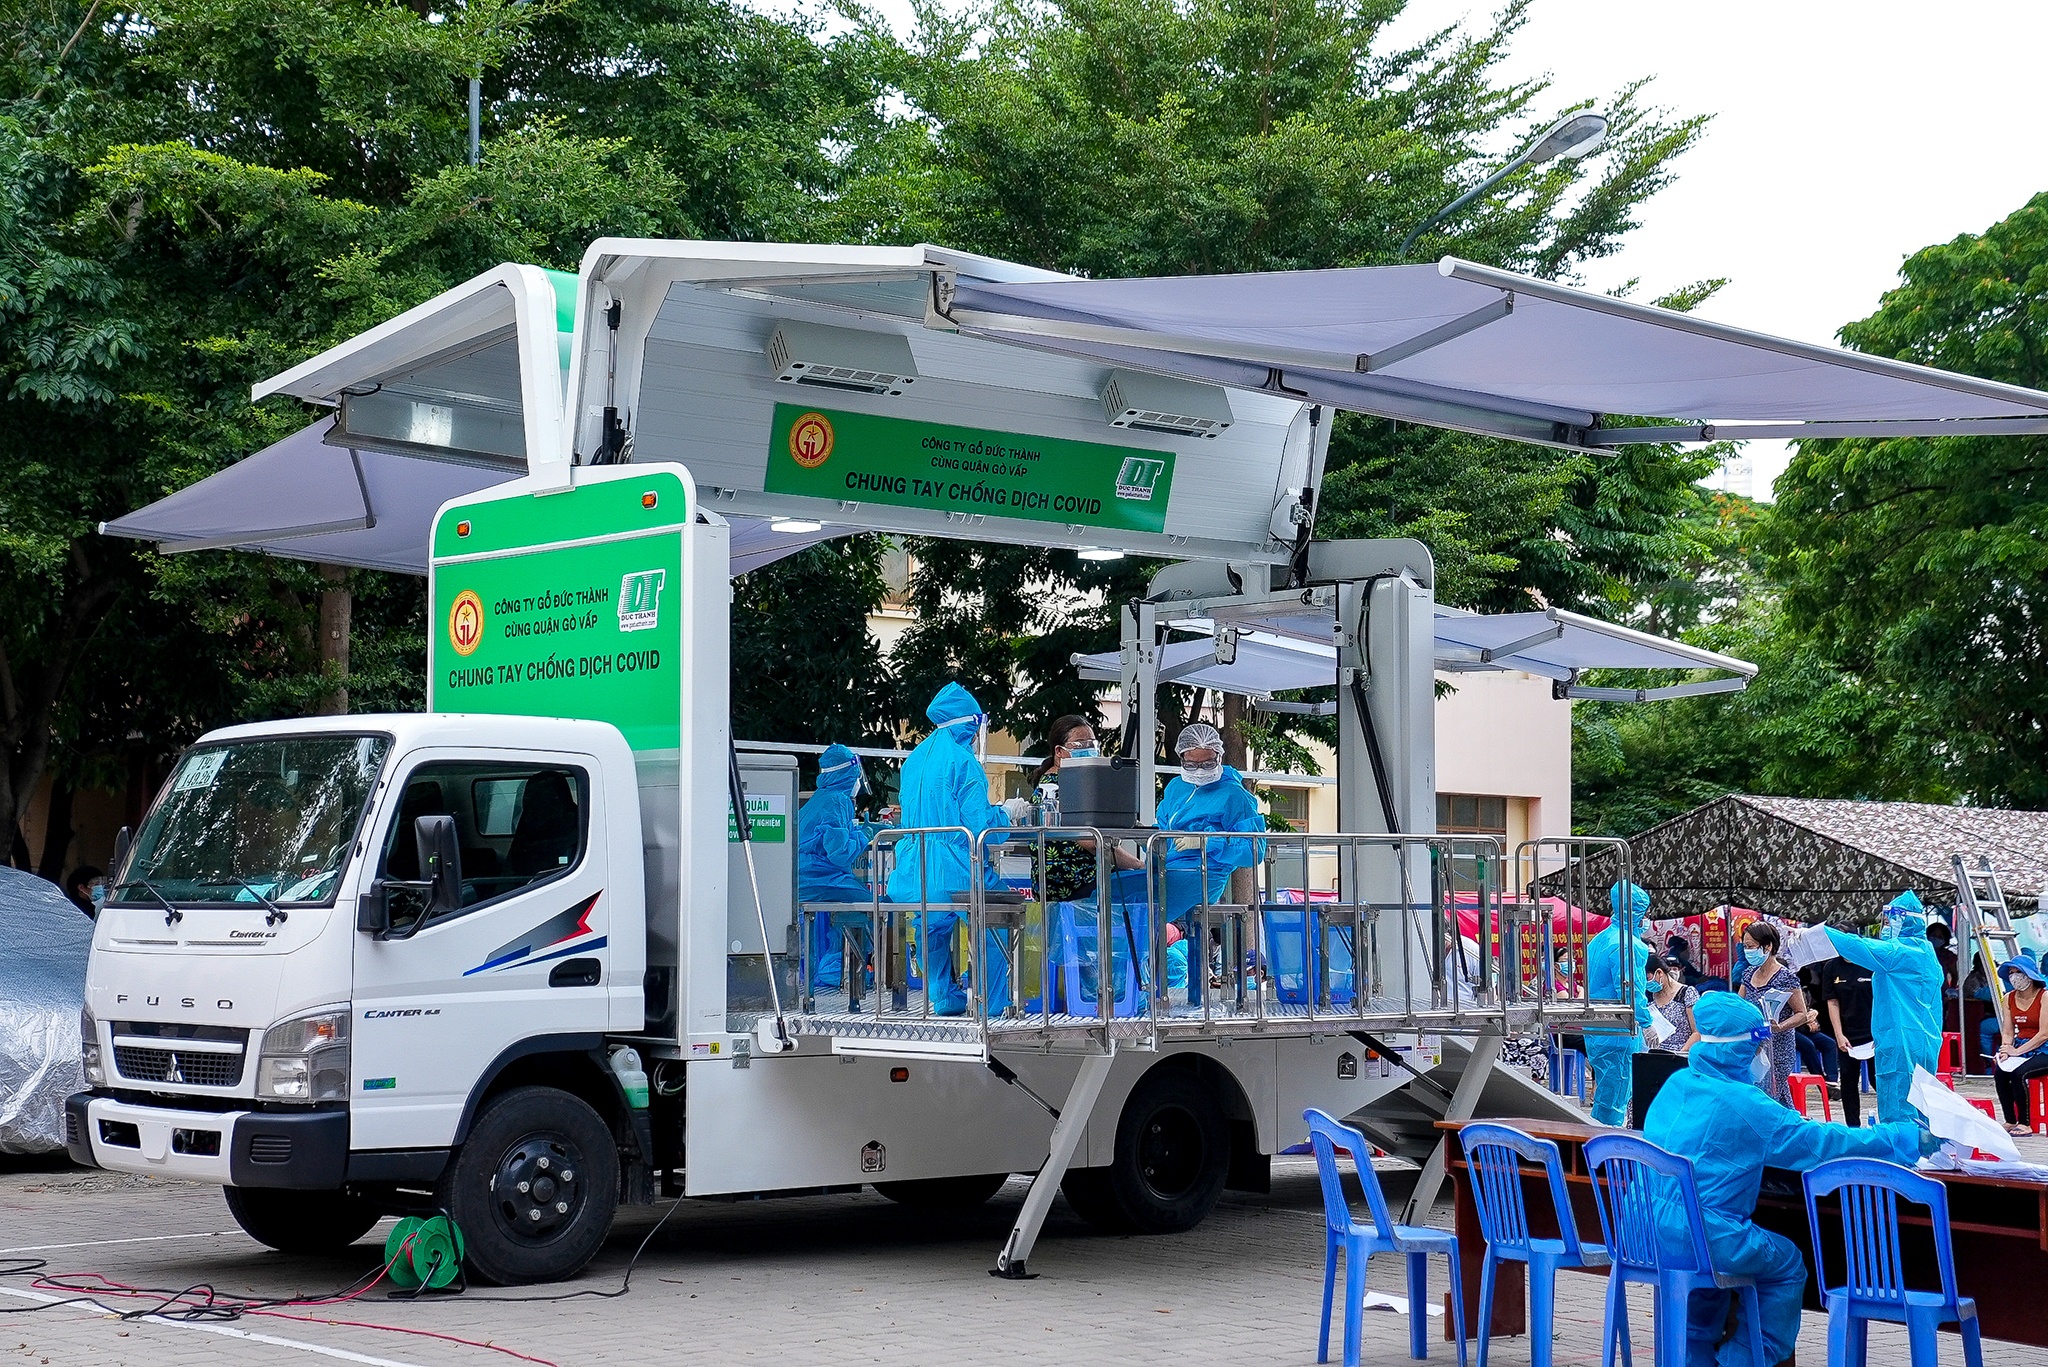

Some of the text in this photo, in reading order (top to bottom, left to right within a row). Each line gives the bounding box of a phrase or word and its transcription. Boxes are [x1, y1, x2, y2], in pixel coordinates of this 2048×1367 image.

[921, 436, 1040, 462] CÔNG TY GỖ ĐỨC THÀNH
[931, 455, 1028, 477] CÙNG QUẬN GÒ VẤP
[845, 471, 1101, 515] CHUNG TAY CHỐNG DỊCH COVID
[494, 598, 521, 615] CÔNG
[523, 598, 535, 612] TY
[537, 590, 551, 610] GỖ
[553, 590, 573, 608] ĐỨC
[576, 587, 608, 605] THÀNH
[504, 610, 598, 638] CÙNG QUẬN GÒ VẤP
[449, 650, 660, 688] CHUNG TAY CHỐNG DỊCH COVID
[745, 797, 769, 811] QUẢN
[117, 994, 233, 1010] FUSO
[364, 1009, 422, 1019] CANTER
